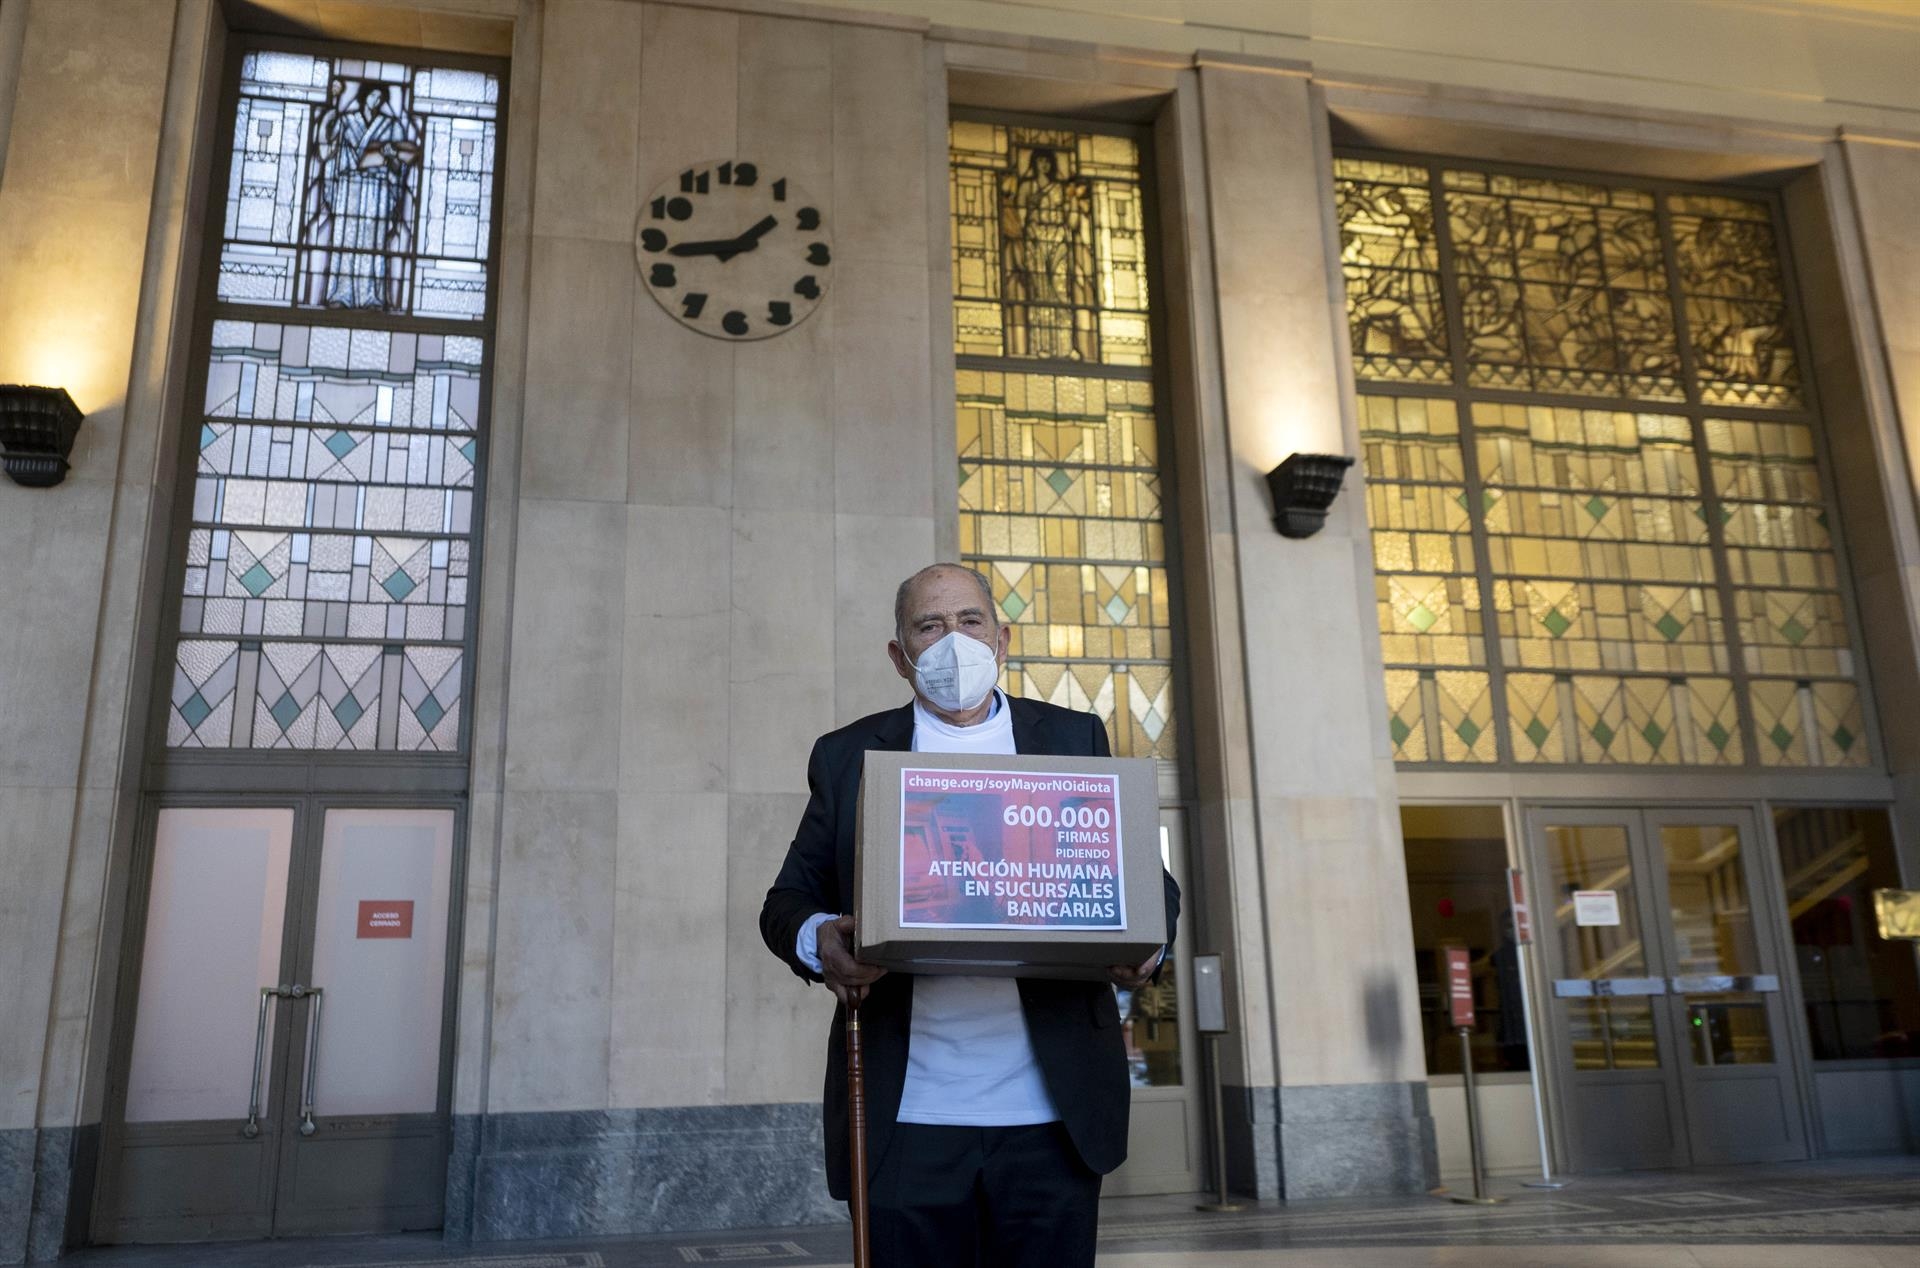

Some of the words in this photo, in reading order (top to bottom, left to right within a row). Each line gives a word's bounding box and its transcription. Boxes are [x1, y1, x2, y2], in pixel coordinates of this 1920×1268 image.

[680, 169, 709, 194] 11
[718, 161, 758, 187] 12
[772, 177, 786, 202] 1
[651, 196, 693, 221] 10
[796, 207, 821, 231] 2
[641, 228, 668, 253] 9
[806, 242, 831, 267] 3
[650, 263, 677, 288] 8
[794, 275, 821, 300] 4
[682, 293, 708, 319] 7
[767, 301, 793, 326] 5
[722, 311, 749, 336] 6
[908, 775, 1111, 793] change.org/soyMayorNOidiota
[1003, 804, 1110, 829] 600.000
[1057, 831, 1110, 844] FIRMAS
[1056, 848, 1110, 859] PIDIENDO
[928, 859, 1023, 877] ATENCIÓN
[1028, 863, 1112, 880] HUMANA
[965, 881, 989, 896] EN
[994, 881, 1114, 899] SUCURSALES
[1007, 901, 1115, 918] BANCARIAS
